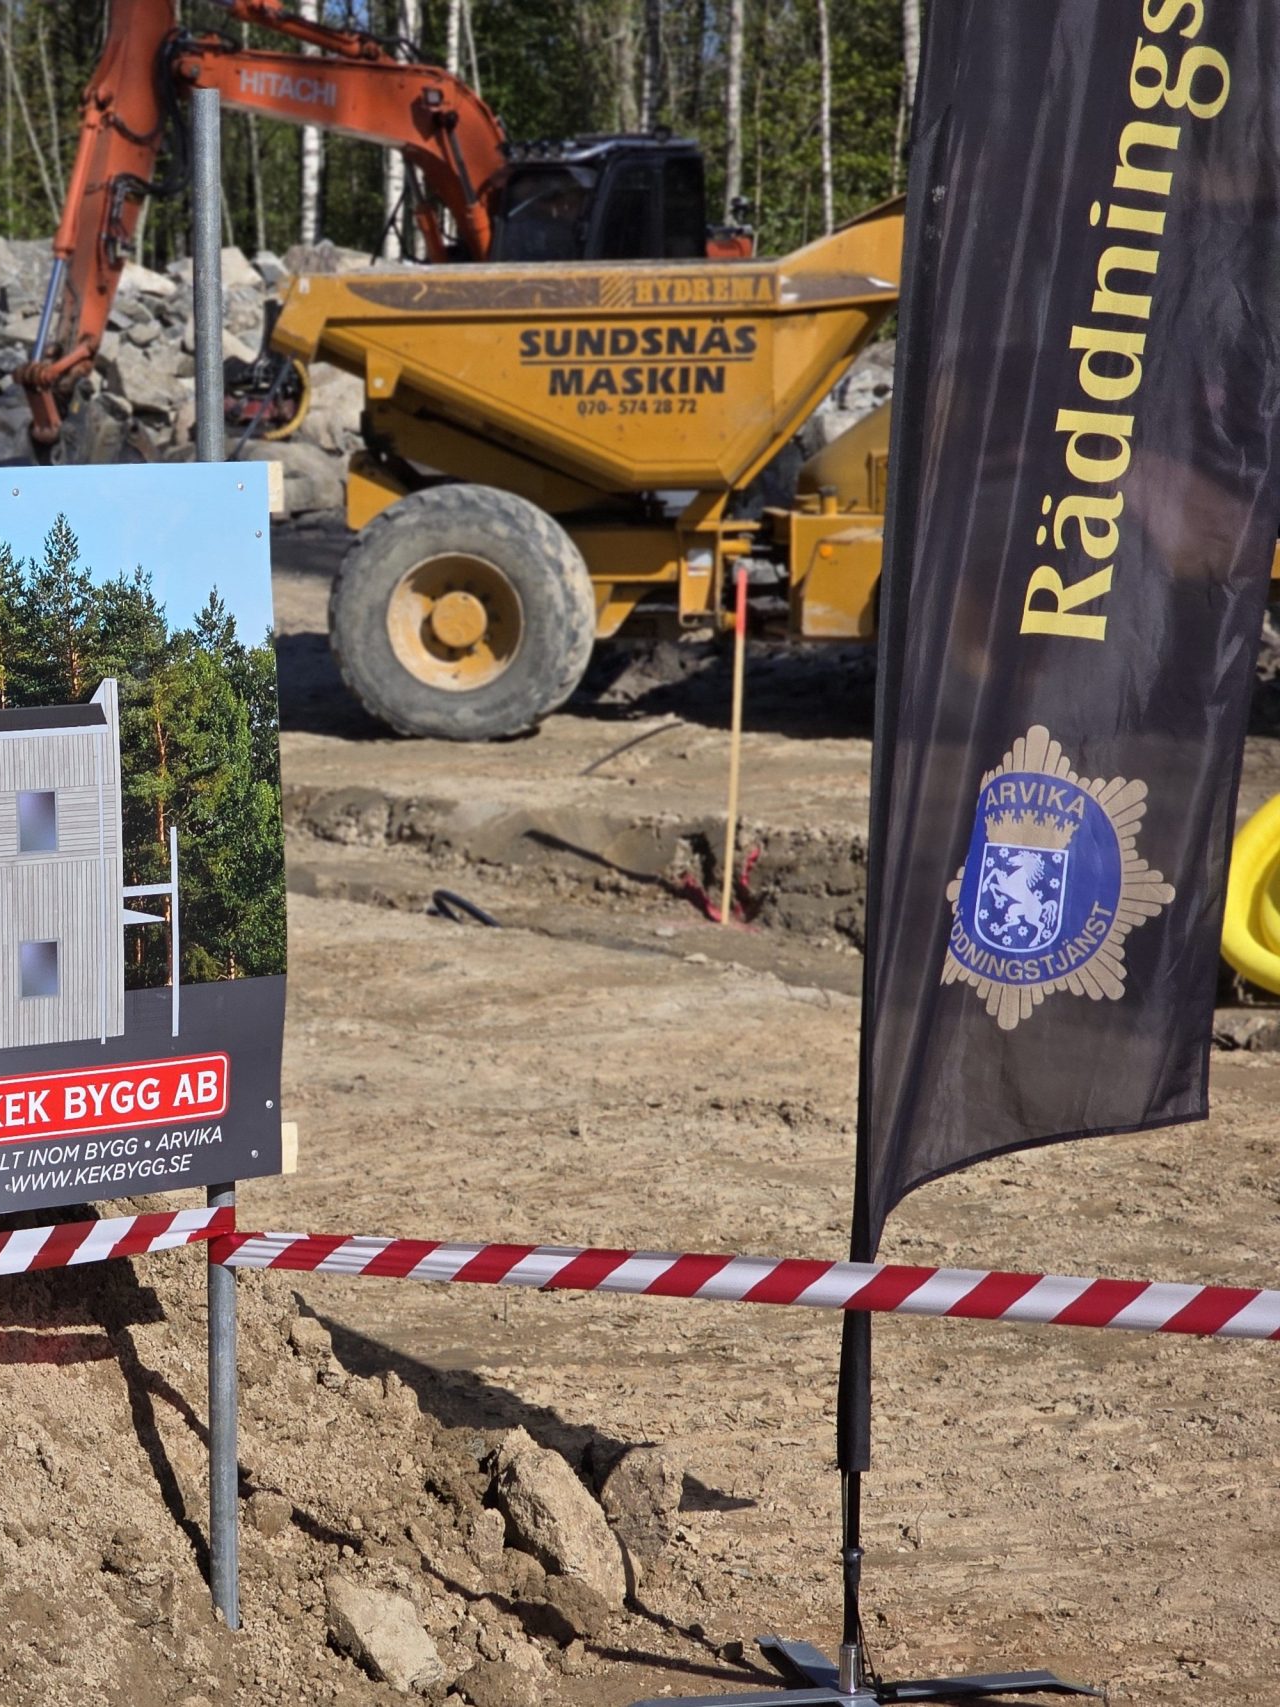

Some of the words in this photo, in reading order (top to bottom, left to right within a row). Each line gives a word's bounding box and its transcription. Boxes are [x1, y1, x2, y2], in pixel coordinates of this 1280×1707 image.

[240, 69, 336, 107] HITACHI
[635, 276, 771, 304] HYDREMA
[519, 317, 757, 357] SUNDSNÄS
[548, 366, 725, 396] MASKIN
[618, 399, 648, 414] 574
[677, 398, 697, 414] 72
[985, 781, 1086, 819] ARVIKA
[64, 1078, 160, 1120] BYGG
[172, 1070, 218, 1107] AB
[28, 1144, 80, 1167] INOM
[85, 1137, 138, 1159] BYGG
[156, 1125, 222, 1152] ARVIKA
[10, 1153, 193, 1194] WWW.KEKBYGG.SE
